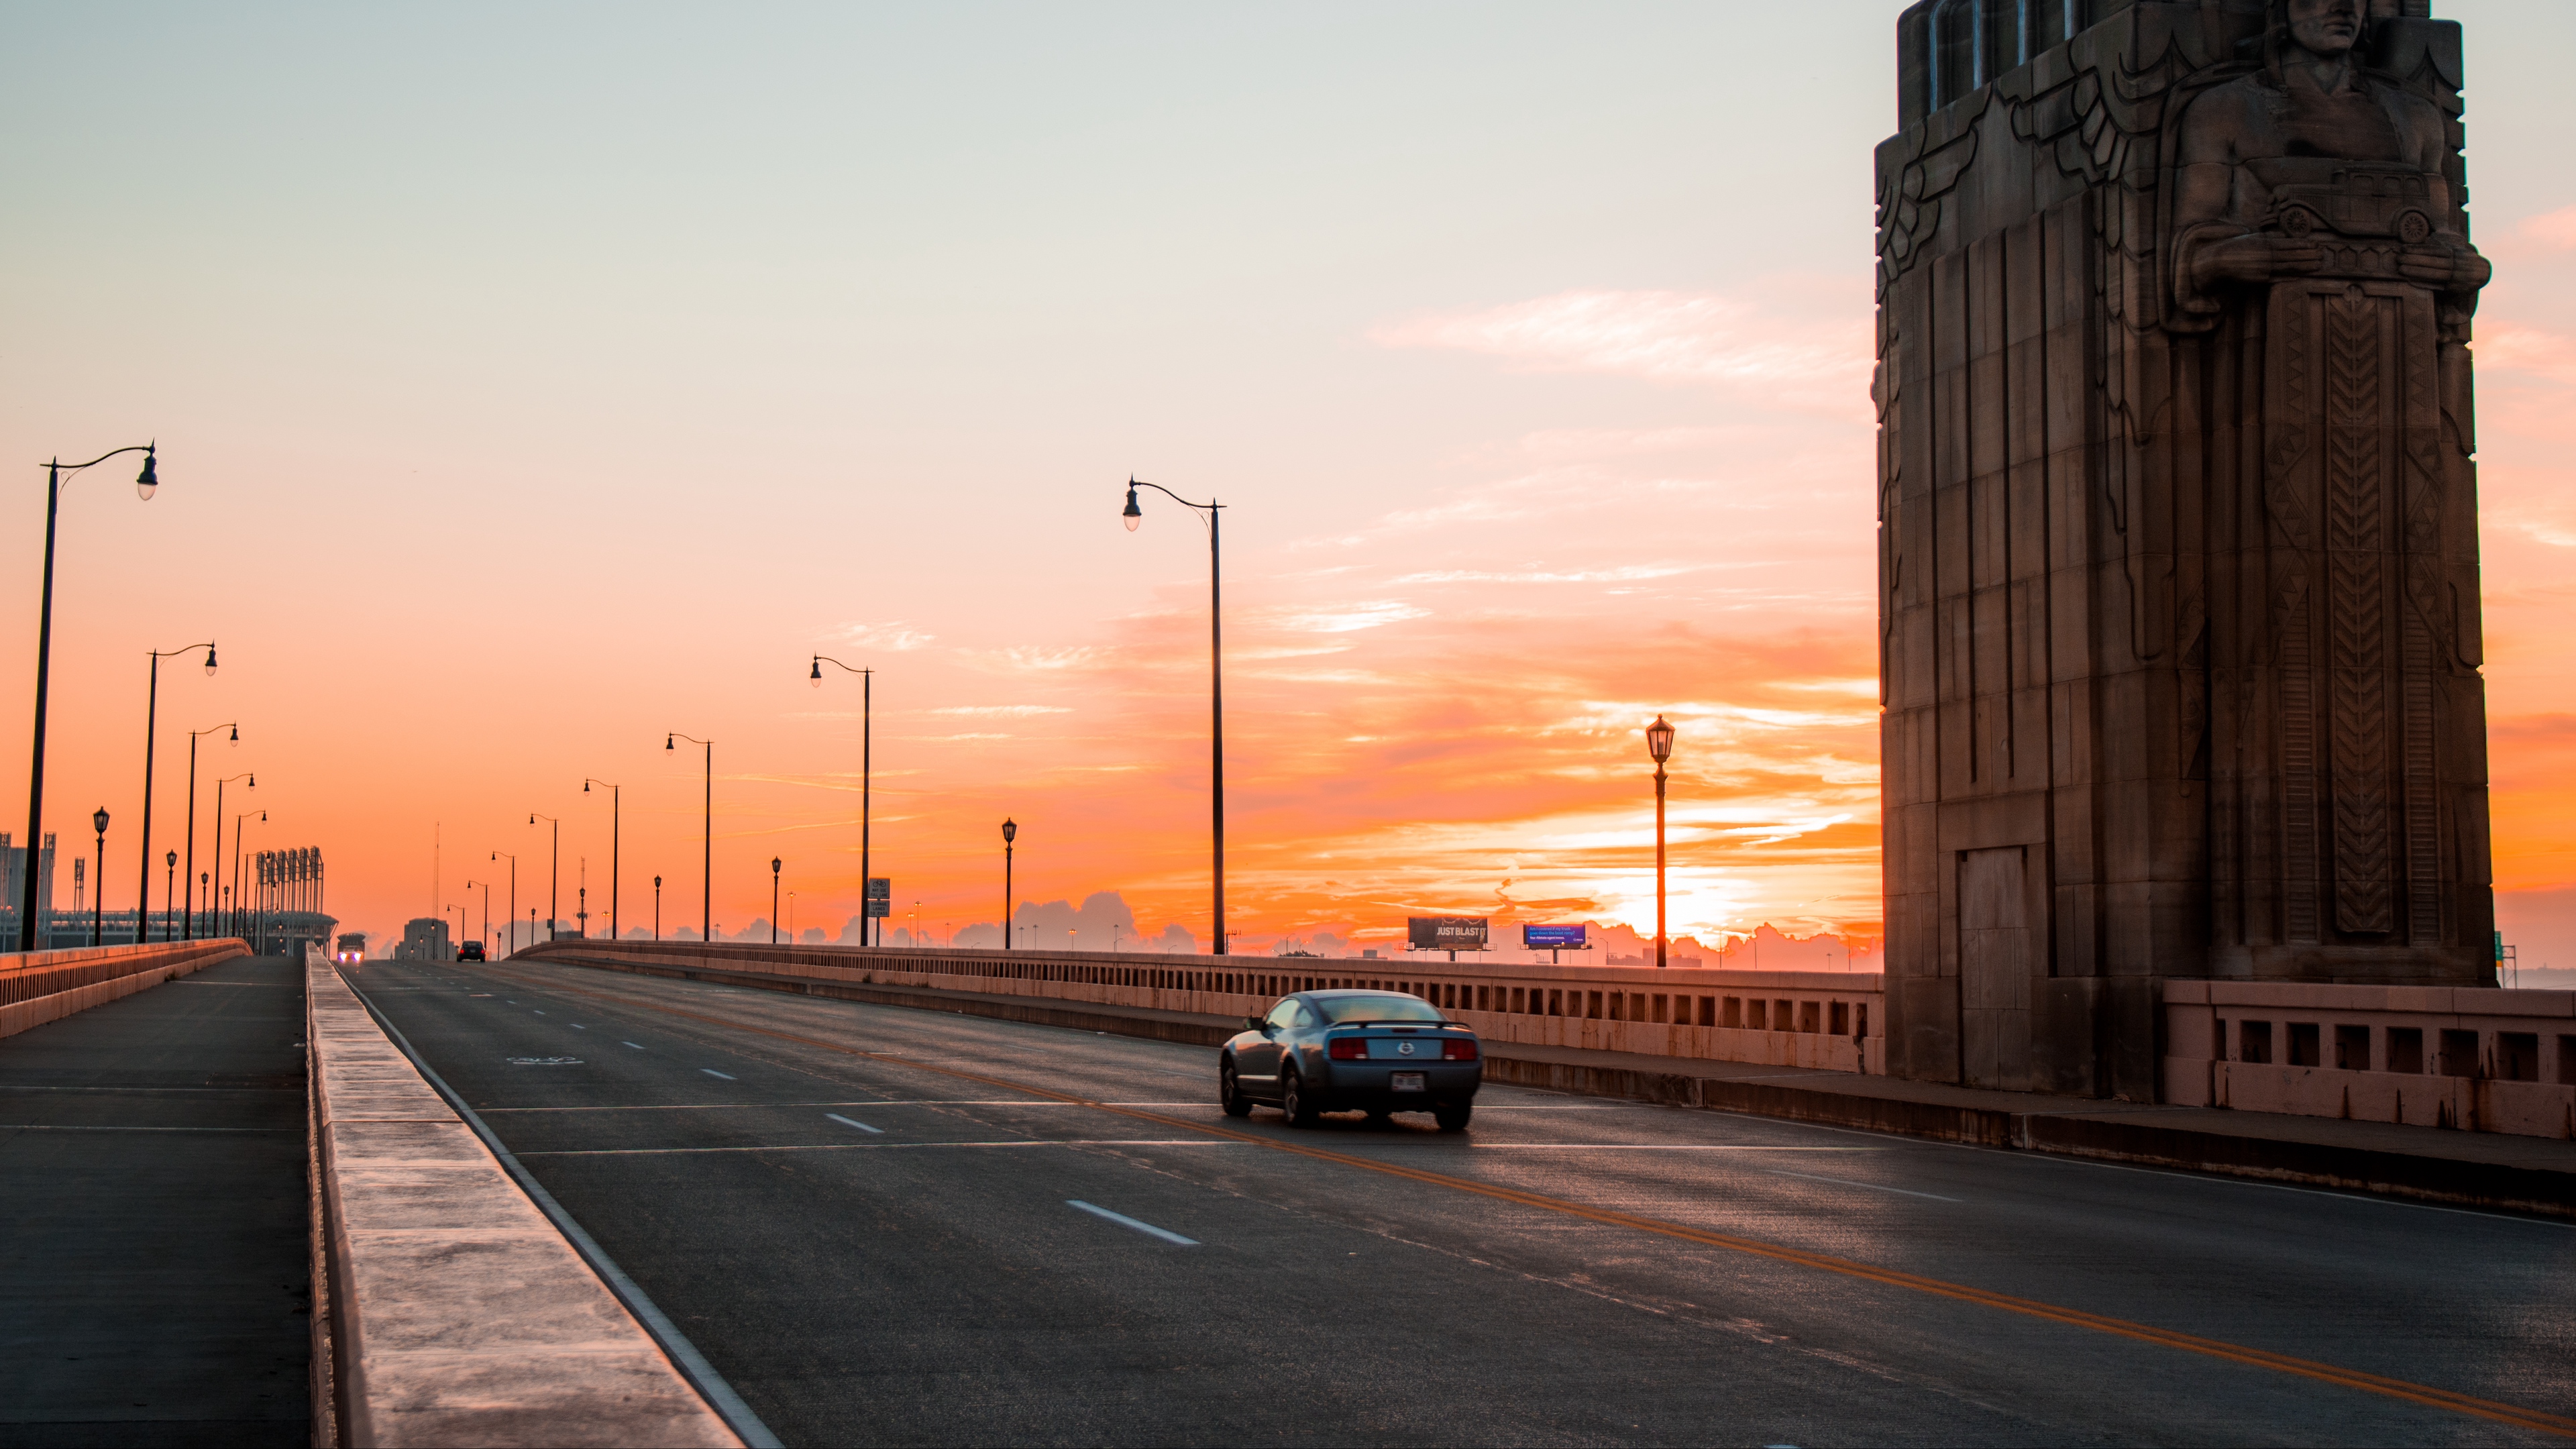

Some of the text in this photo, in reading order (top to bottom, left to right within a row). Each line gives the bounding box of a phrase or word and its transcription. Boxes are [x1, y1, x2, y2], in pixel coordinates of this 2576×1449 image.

[1437, 926, 1487, 936] JUST BLAST IT
